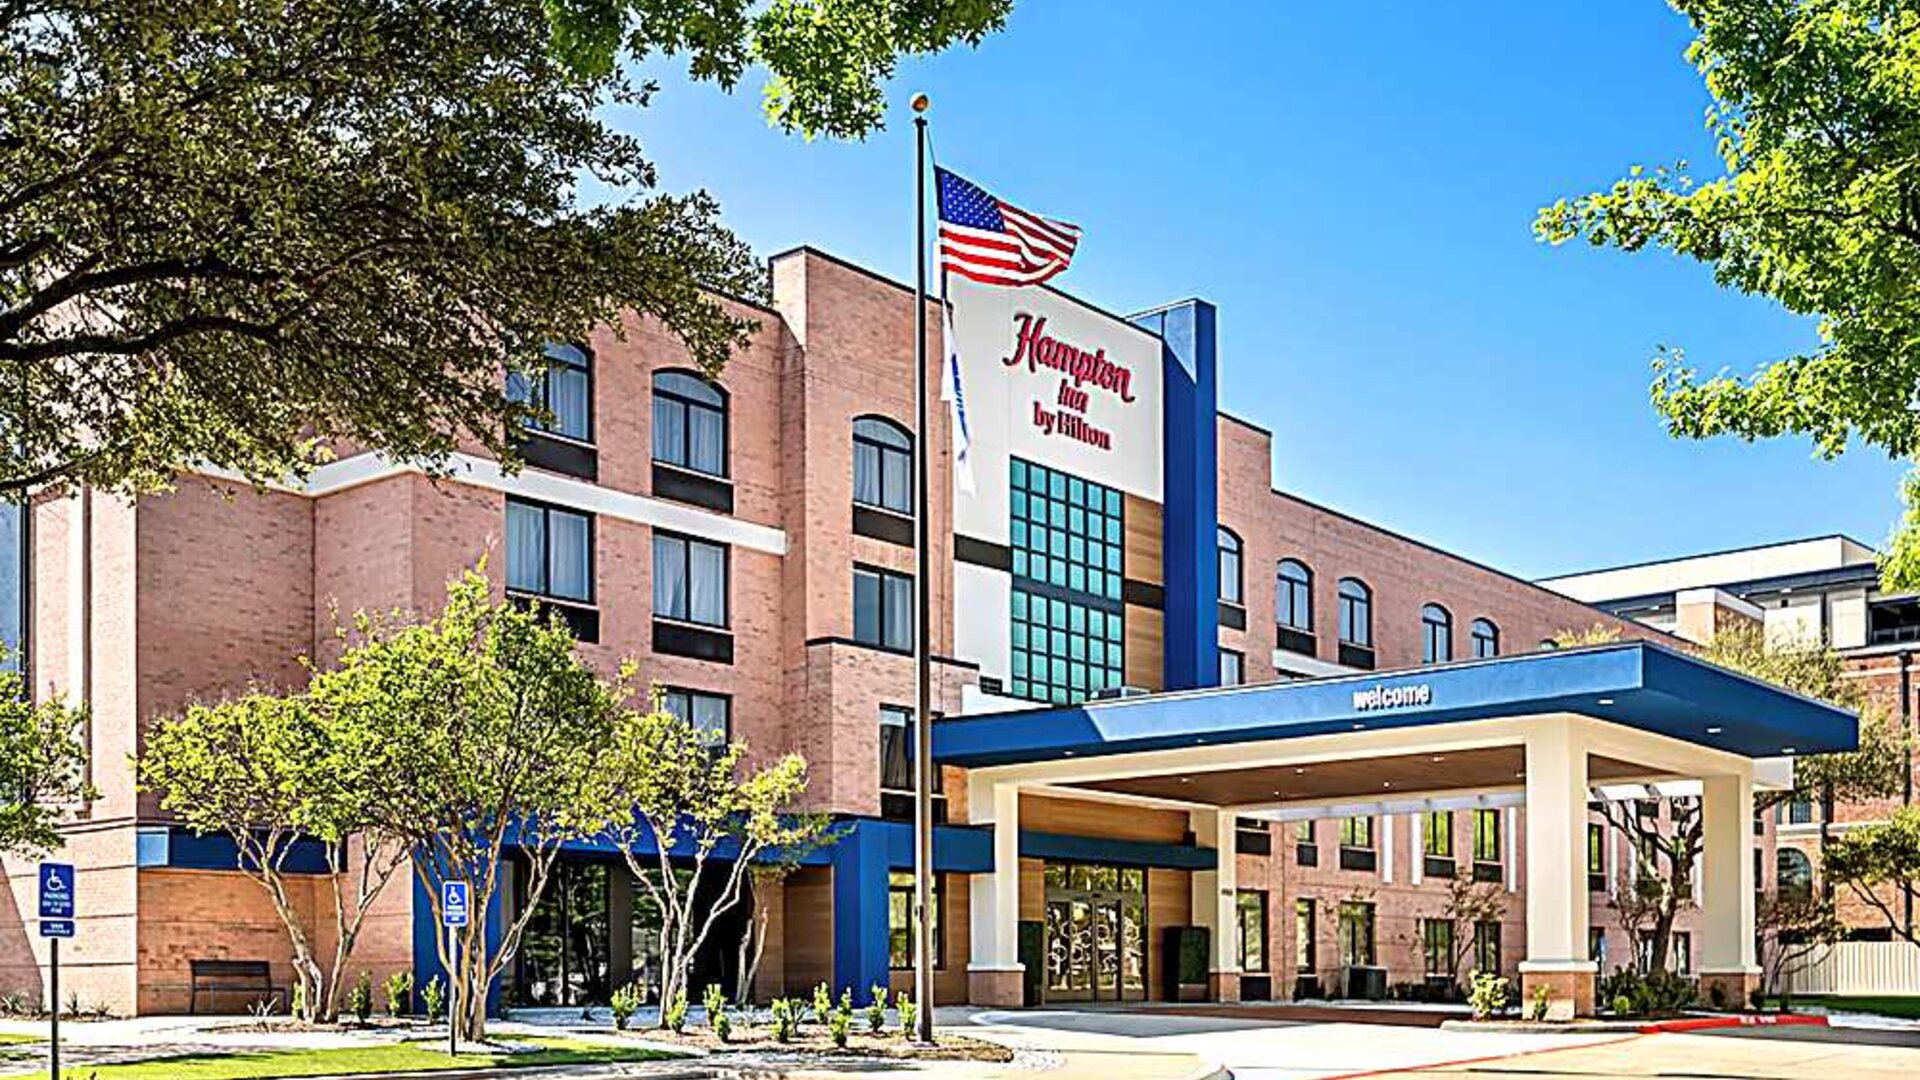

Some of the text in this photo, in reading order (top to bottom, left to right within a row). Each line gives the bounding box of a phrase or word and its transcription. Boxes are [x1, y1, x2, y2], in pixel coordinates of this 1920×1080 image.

[1002, 312, 1136, 403] Hampton
[1057, 378, 1089, 413] Inn
[1033, 401, 1111, 450] by Hilton
[1352, 684, 1431, 711] welcome
